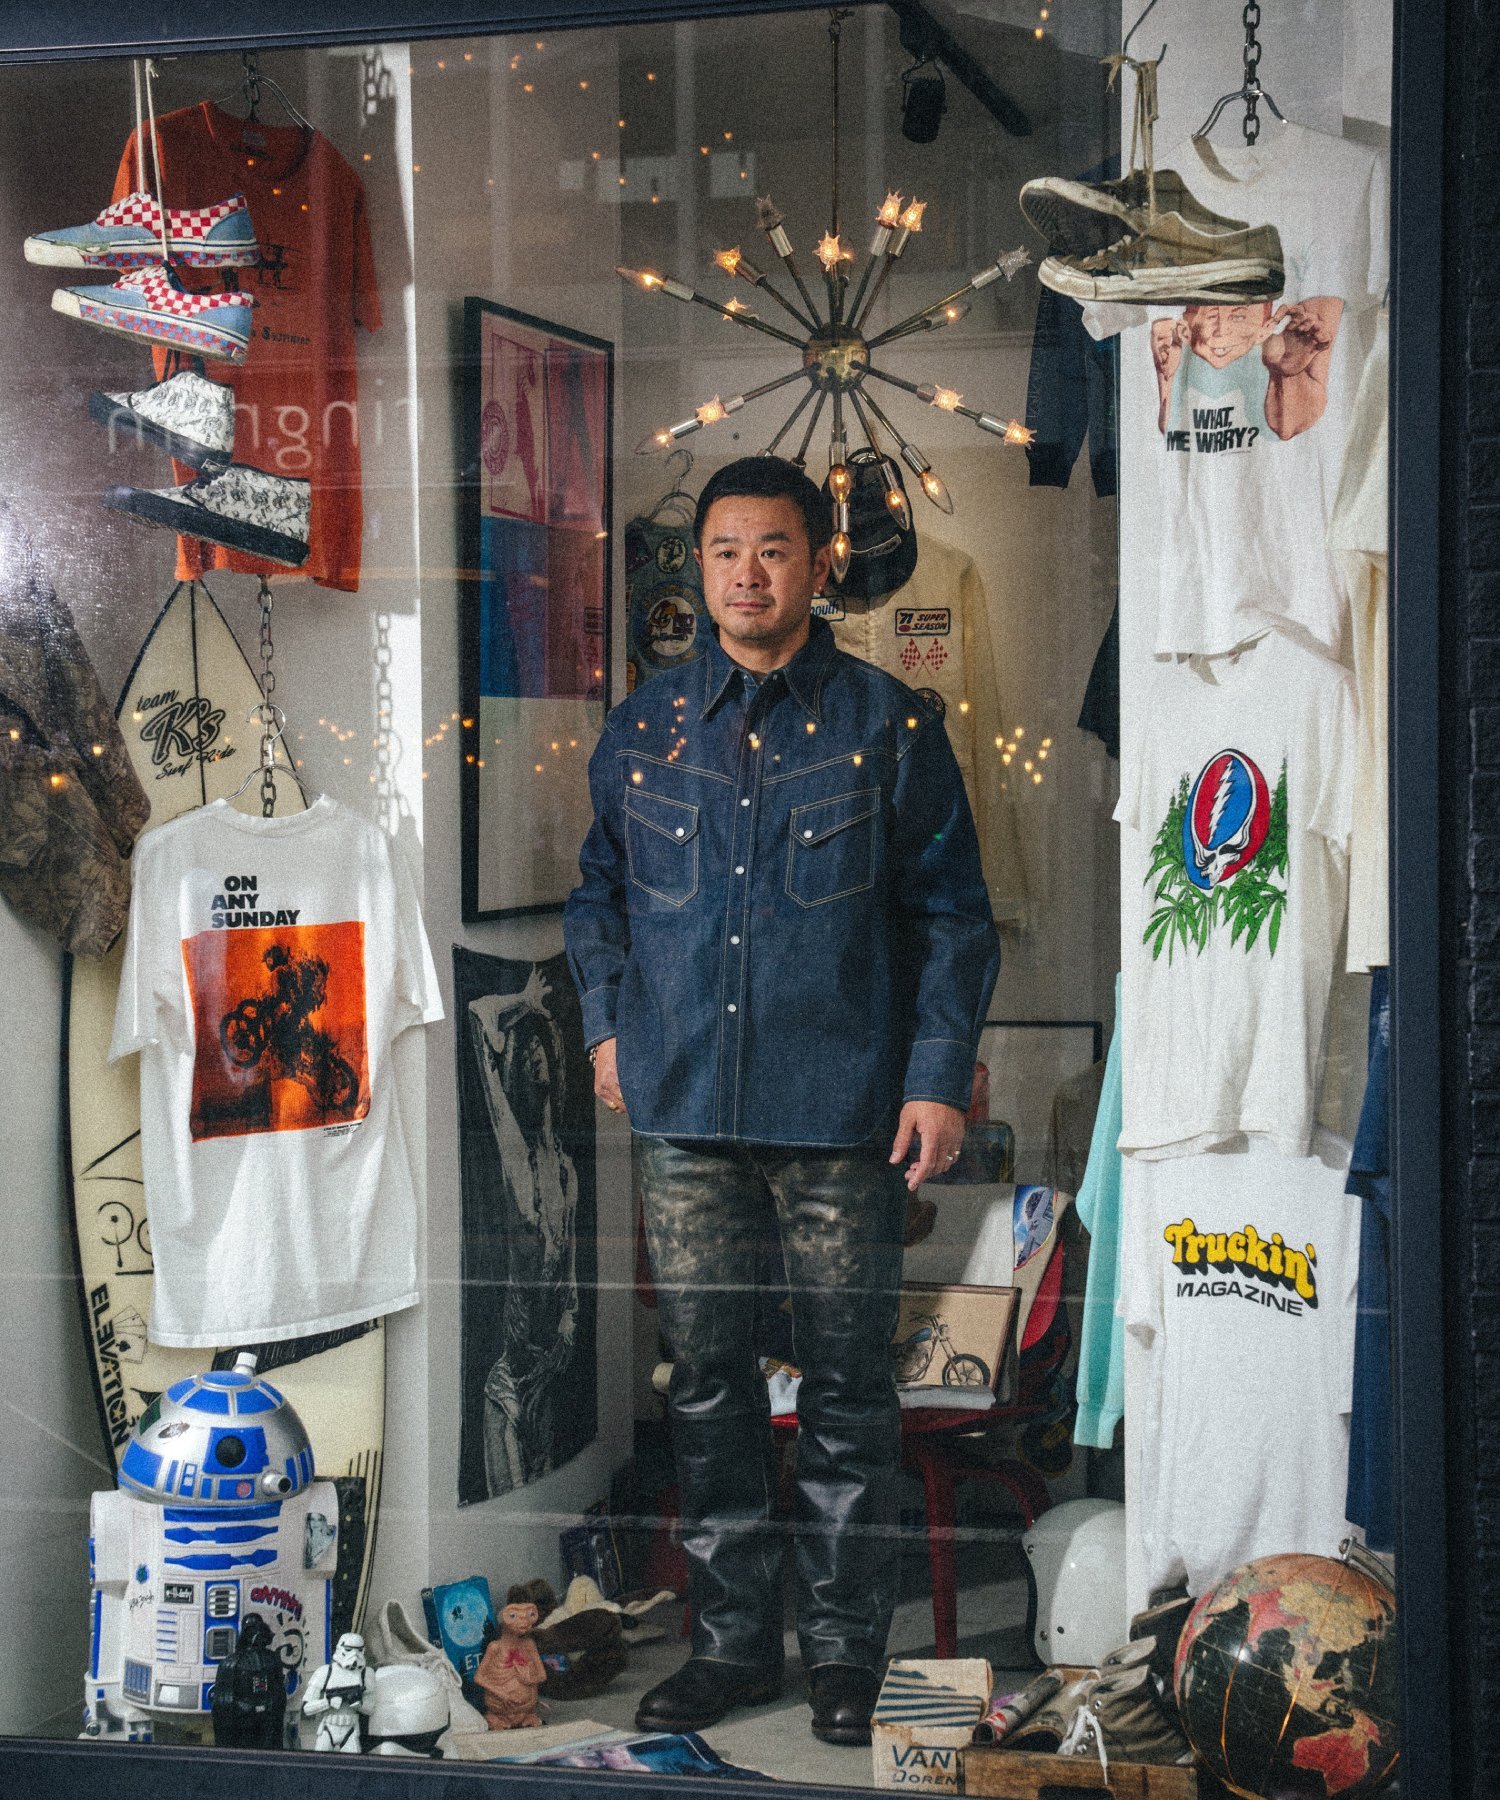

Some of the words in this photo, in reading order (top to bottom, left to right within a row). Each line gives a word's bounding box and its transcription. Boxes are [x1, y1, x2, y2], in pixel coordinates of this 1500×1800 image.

[1193, 406, 1234, 429] WHAT,
[1167, 430, 1190, 452] ME
[912, 622, 947, 631] SEASON
[917, 613, 946, 621] SUPER
[137, 690, 179, 711] team
[224, 875, 257, 891] ON
[211, 893, 259, 910] ANY
[212, 909, 300, 928] SUNDAY
[1164, 1218, 1318, 1309] Truckin'
[1177, 1281, 1303, 1317] MAGAZINE
[91, 1283, 130, 1448] ELEVATION
[892, 1745, 957, 1768] VAN
[893, 1769, 958, 1785] DOREN
